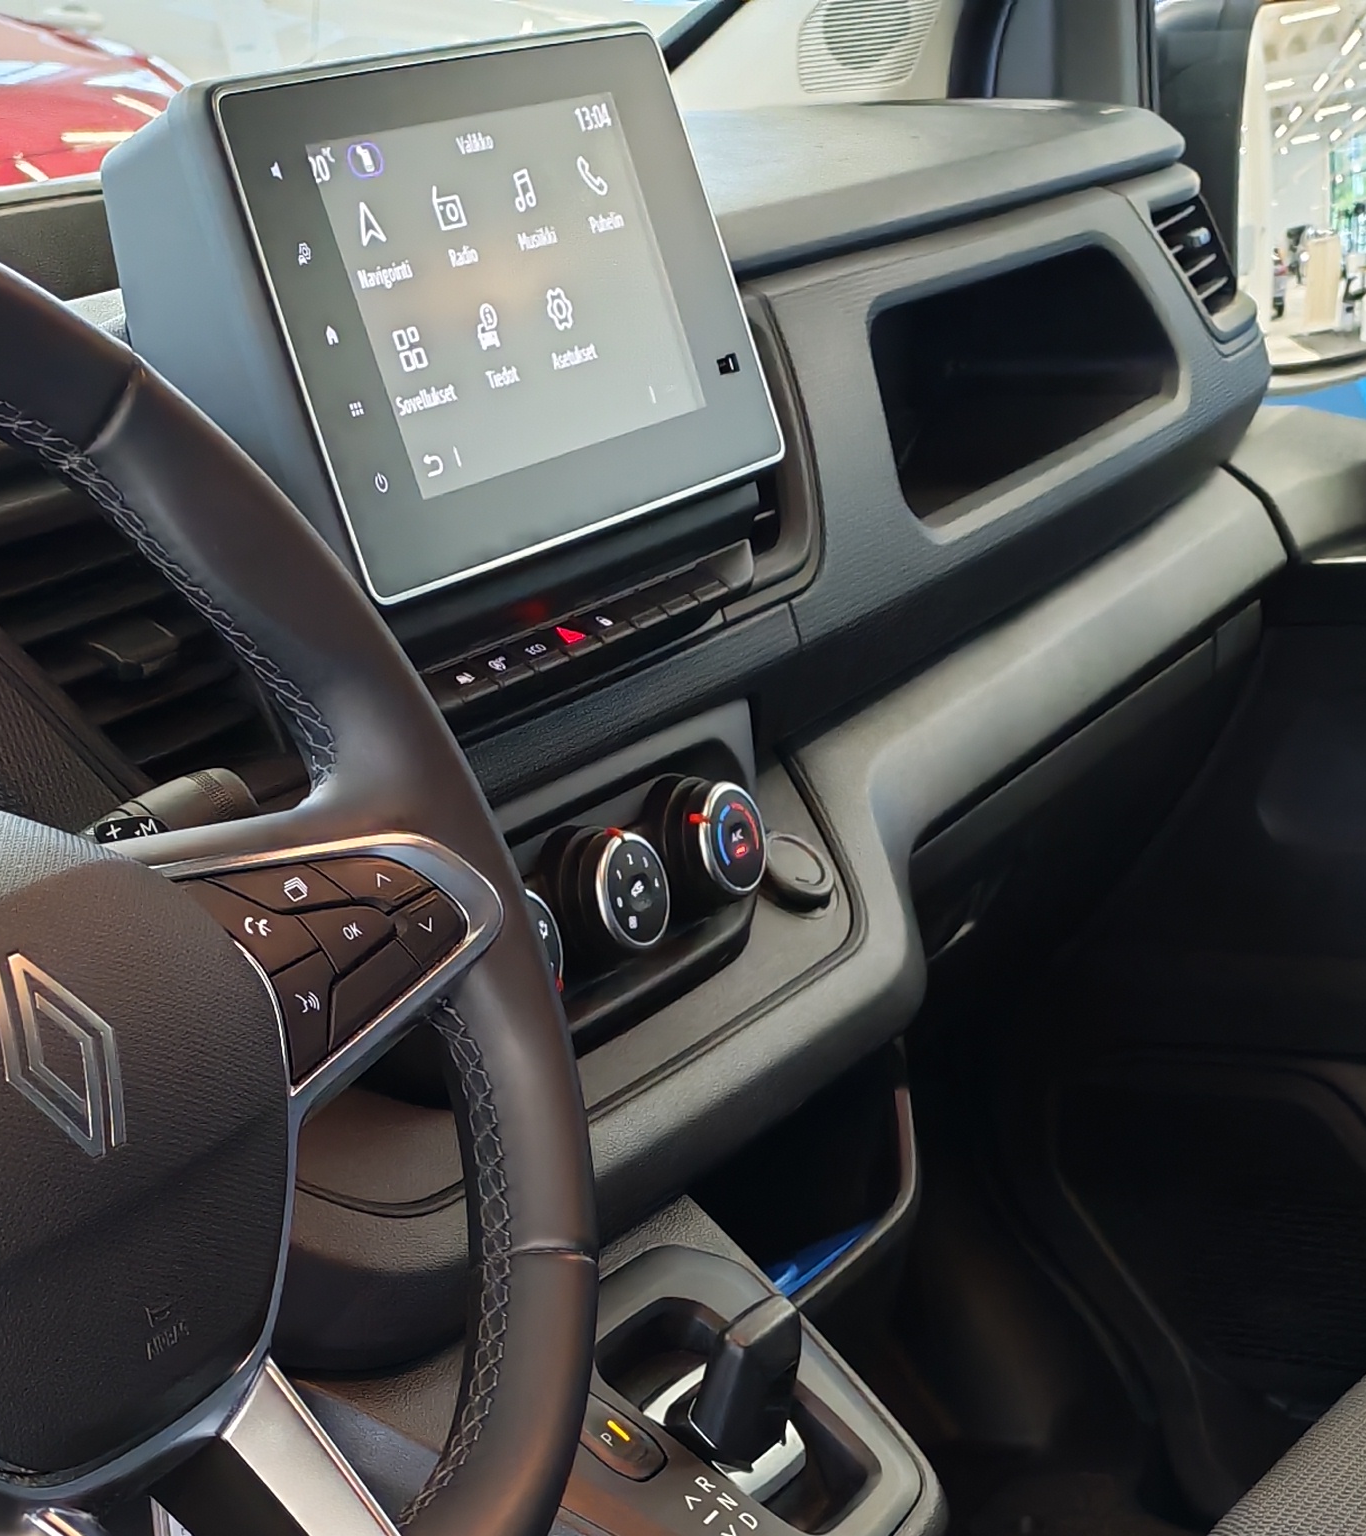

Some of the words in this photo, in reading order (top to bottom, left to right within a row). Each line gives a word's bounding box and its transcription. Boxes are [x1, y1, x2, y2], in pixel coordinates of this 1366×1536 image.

[574, 103, 612, 132] 13:04
[588, 211, 625, 235] Puhelin
[517, 226, 558, 252] Musiikki
[448, 245, 479, 268] Radio
[356, 260, 413, 289] Navigointi
[551, 343, 598, 371] Asetukset
[485, 365, 520, 389] Tiedot
[395, 384, 458, 416] Sovellukset
[342, 921, 363, 942] OK
[600, 1432, 614, 1447] P
[694, 1476, 716, 1493] R
[716, 1492, 738, 1511] N
[738, 1512, 758, 1530] D
